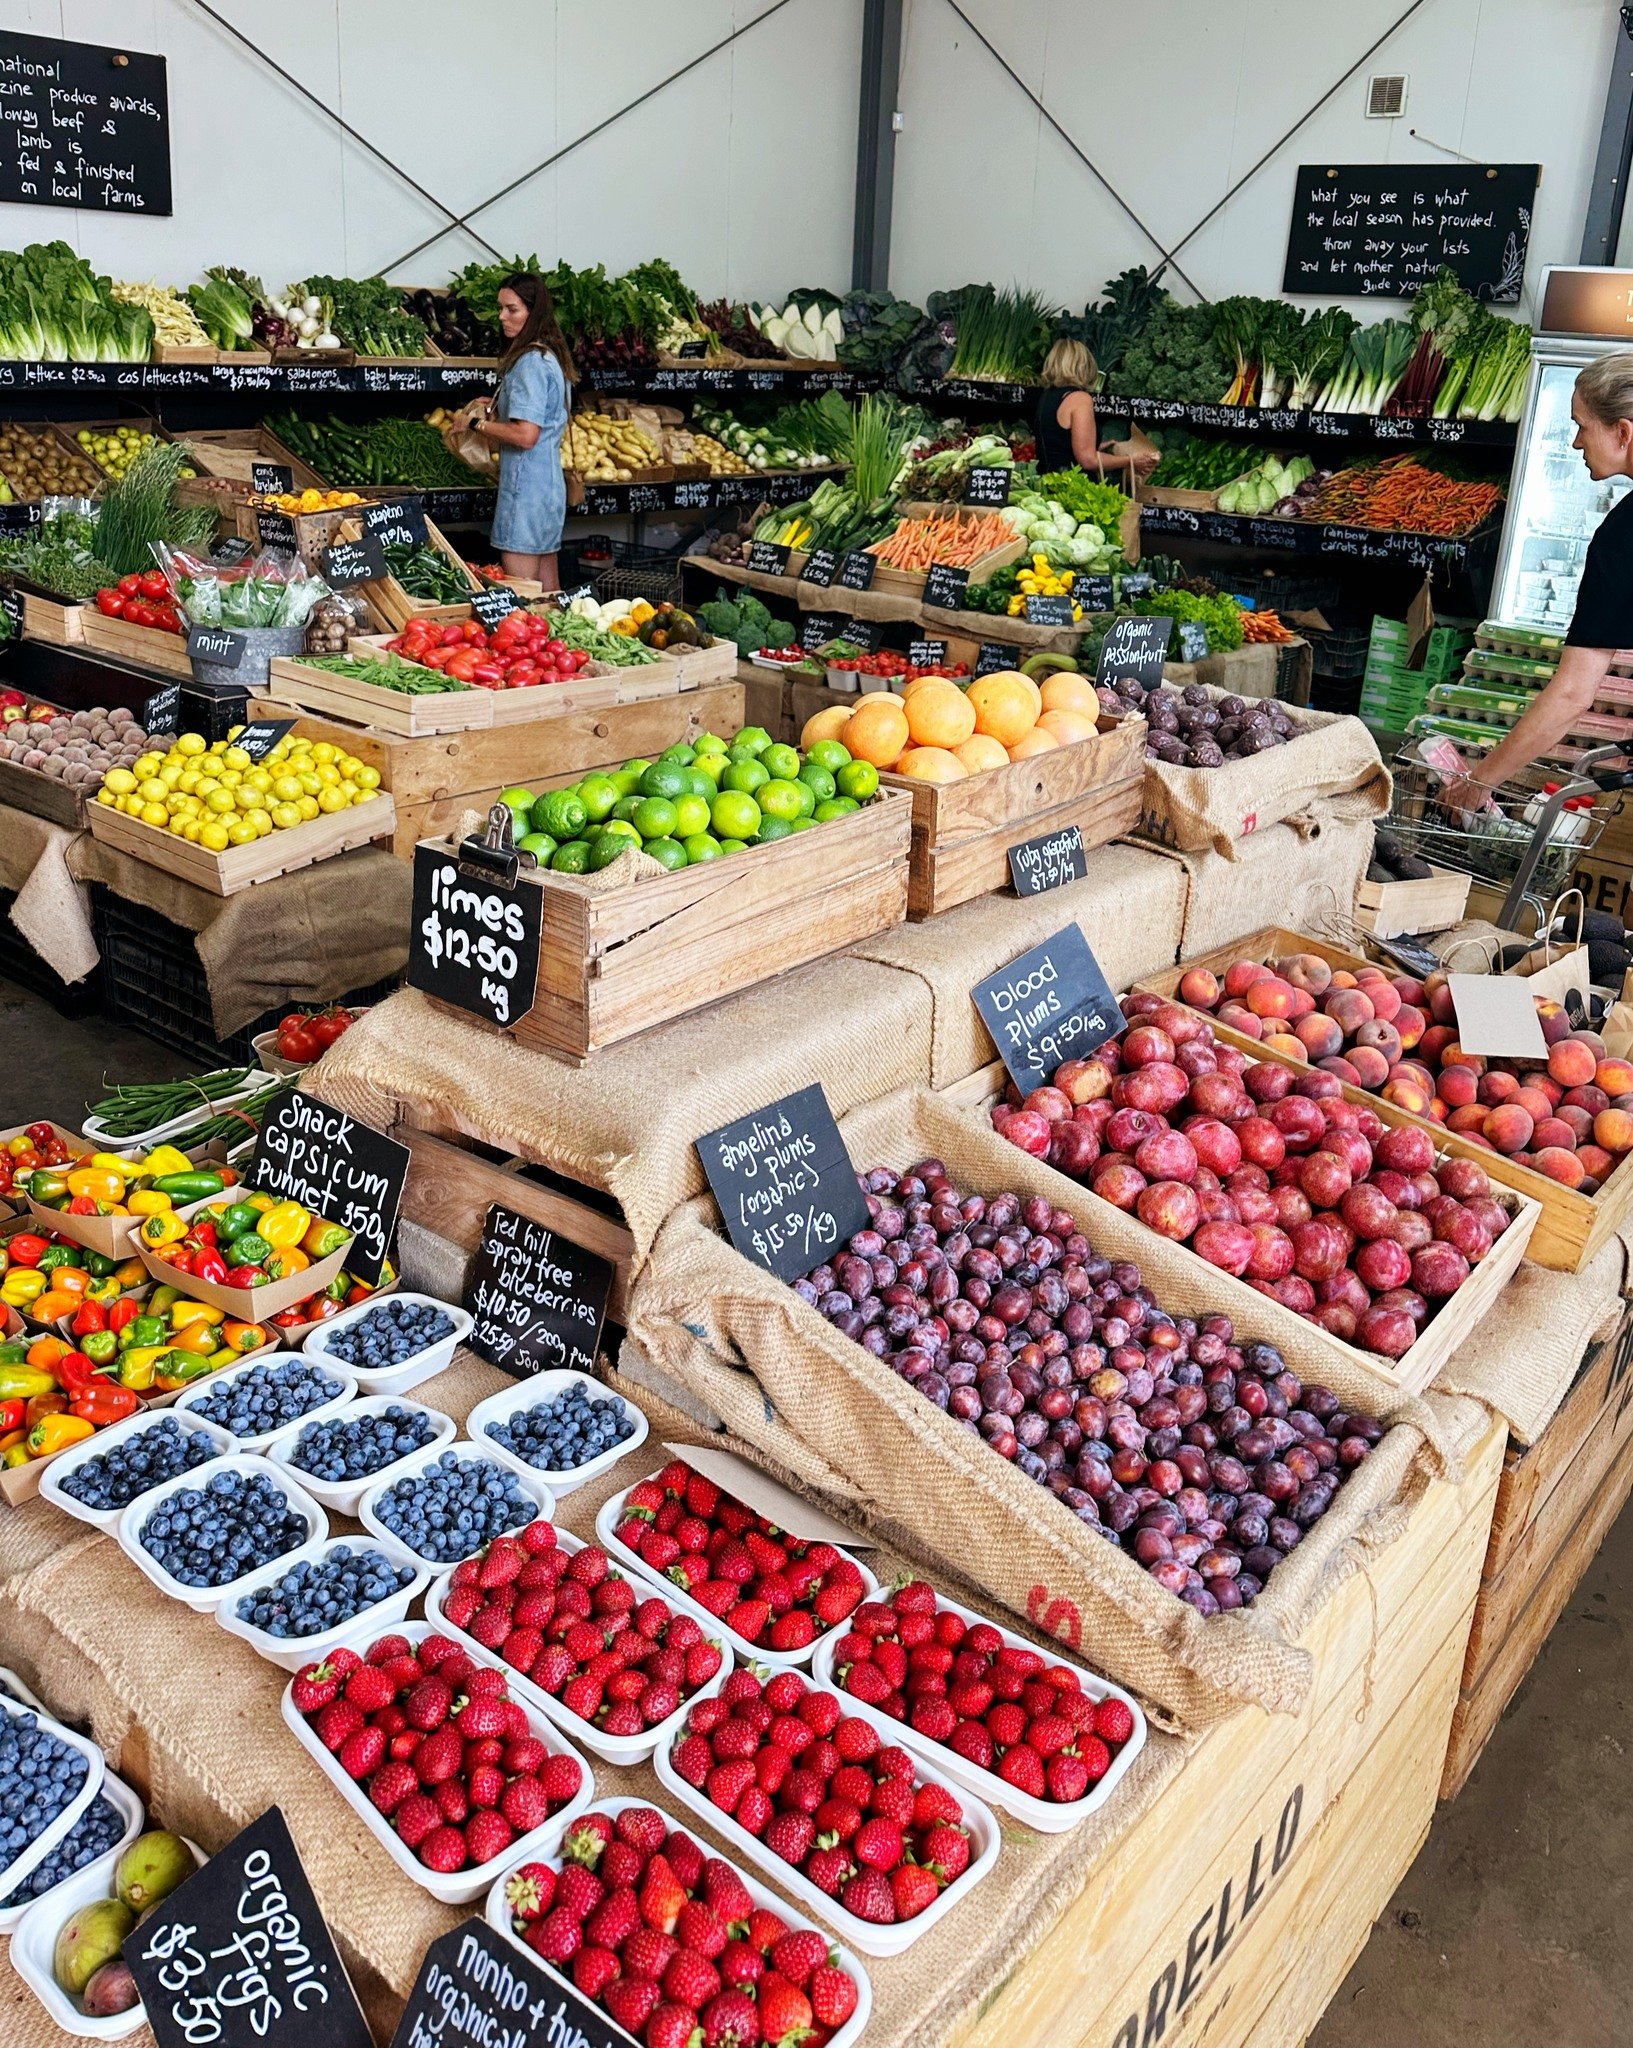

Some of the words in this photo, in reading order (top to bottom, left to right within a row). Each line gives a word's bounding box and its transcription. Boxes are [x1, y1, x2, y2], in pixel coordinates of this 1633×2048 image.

[50, 88, 98, 108] produce
[110, 95, 161, 121] awards,
[52, 110, 85, 133] beef
[17, 129, 52, 149] lamb
[68, 137, 83, 154] is
[17, 152, 40, 174] fed
[75, 157, 135, 183] finished
[21, 181, 37, 195] on
[52, 178, 82, 200] local
[101, 184, 145, 207] farms
[1311, 188, 1338, 203] what
[1347, 190, 1371, 209] you
[1380, 191, 1398, 205] see
[1413, 190, 1425, 205] is
[1435, 188, 1469, 206] what
[1307, 211, 1325, 228] the
[1332, 210, 1359, 228] local
[1366, 213, 1403, 226] season
[1412, 211, 1434, 226] has
[1440, 211, 1497, 235] provided.
[1322, 236, 1352, 251] throw
[1364, 238, 1395, 258] away
[1401, 241, 1429, 258] your
[1443, 237, 1470, 255] lists
[1300, 260, 1320, 273] and
[1330, 259, 1347, 273] let
[1353, 259, 1394, 274] mother
[1405, 258, 1442, 275] natur
[1362, 278, 1391, 294] guide
[25, 363, 66, 385] lettuce
[117, 371, 140, 384] cos
[142, 366, 179, 387] lettuce
[212, 365, 234, 379] large
[1308, 411, 1336, 427] leeks
[1369, 417, 1414, 430] rhubarb
[1427, 419, 1464, 435] celery
[328, 543, 353, 559] black
[1383, 534, 1423, 551] dutch
[335, 549, 365, 568] garlic
[807, 617, 834, 629] organic
[848, 621, 872, 635] organic
[1116, 618, 1153, 651] organic
[196, 634, 235, 656] mint
[1103, 638, 1168, 672] passionfruit
[1016, 844, 1042, 873] ruby
[1042, 826, 1083, 869] grapefruit
[431, 865, 526, 942] limes
[421, 909, 518, 979] $12.50
[990, 955, 1058, 1012] blood
[481, 976, 510, 1022] kg
[718, 1112, 793, 1177] angelina
[740, 1160, 820, 1227] (organic)
[494, 1211, 520, 1240] Ted
[524, 1223, 552, 1256] hill
[486, 1238, 533, 1282] spray
[535, 1256, 573, 1288] free
[498, 1261, 596, 1327] blueberries
[236, 1849, 329, 2012] organic
[141, 1922, 222, 2045] $3.50
[210, 1930, 282, 2037] figs
